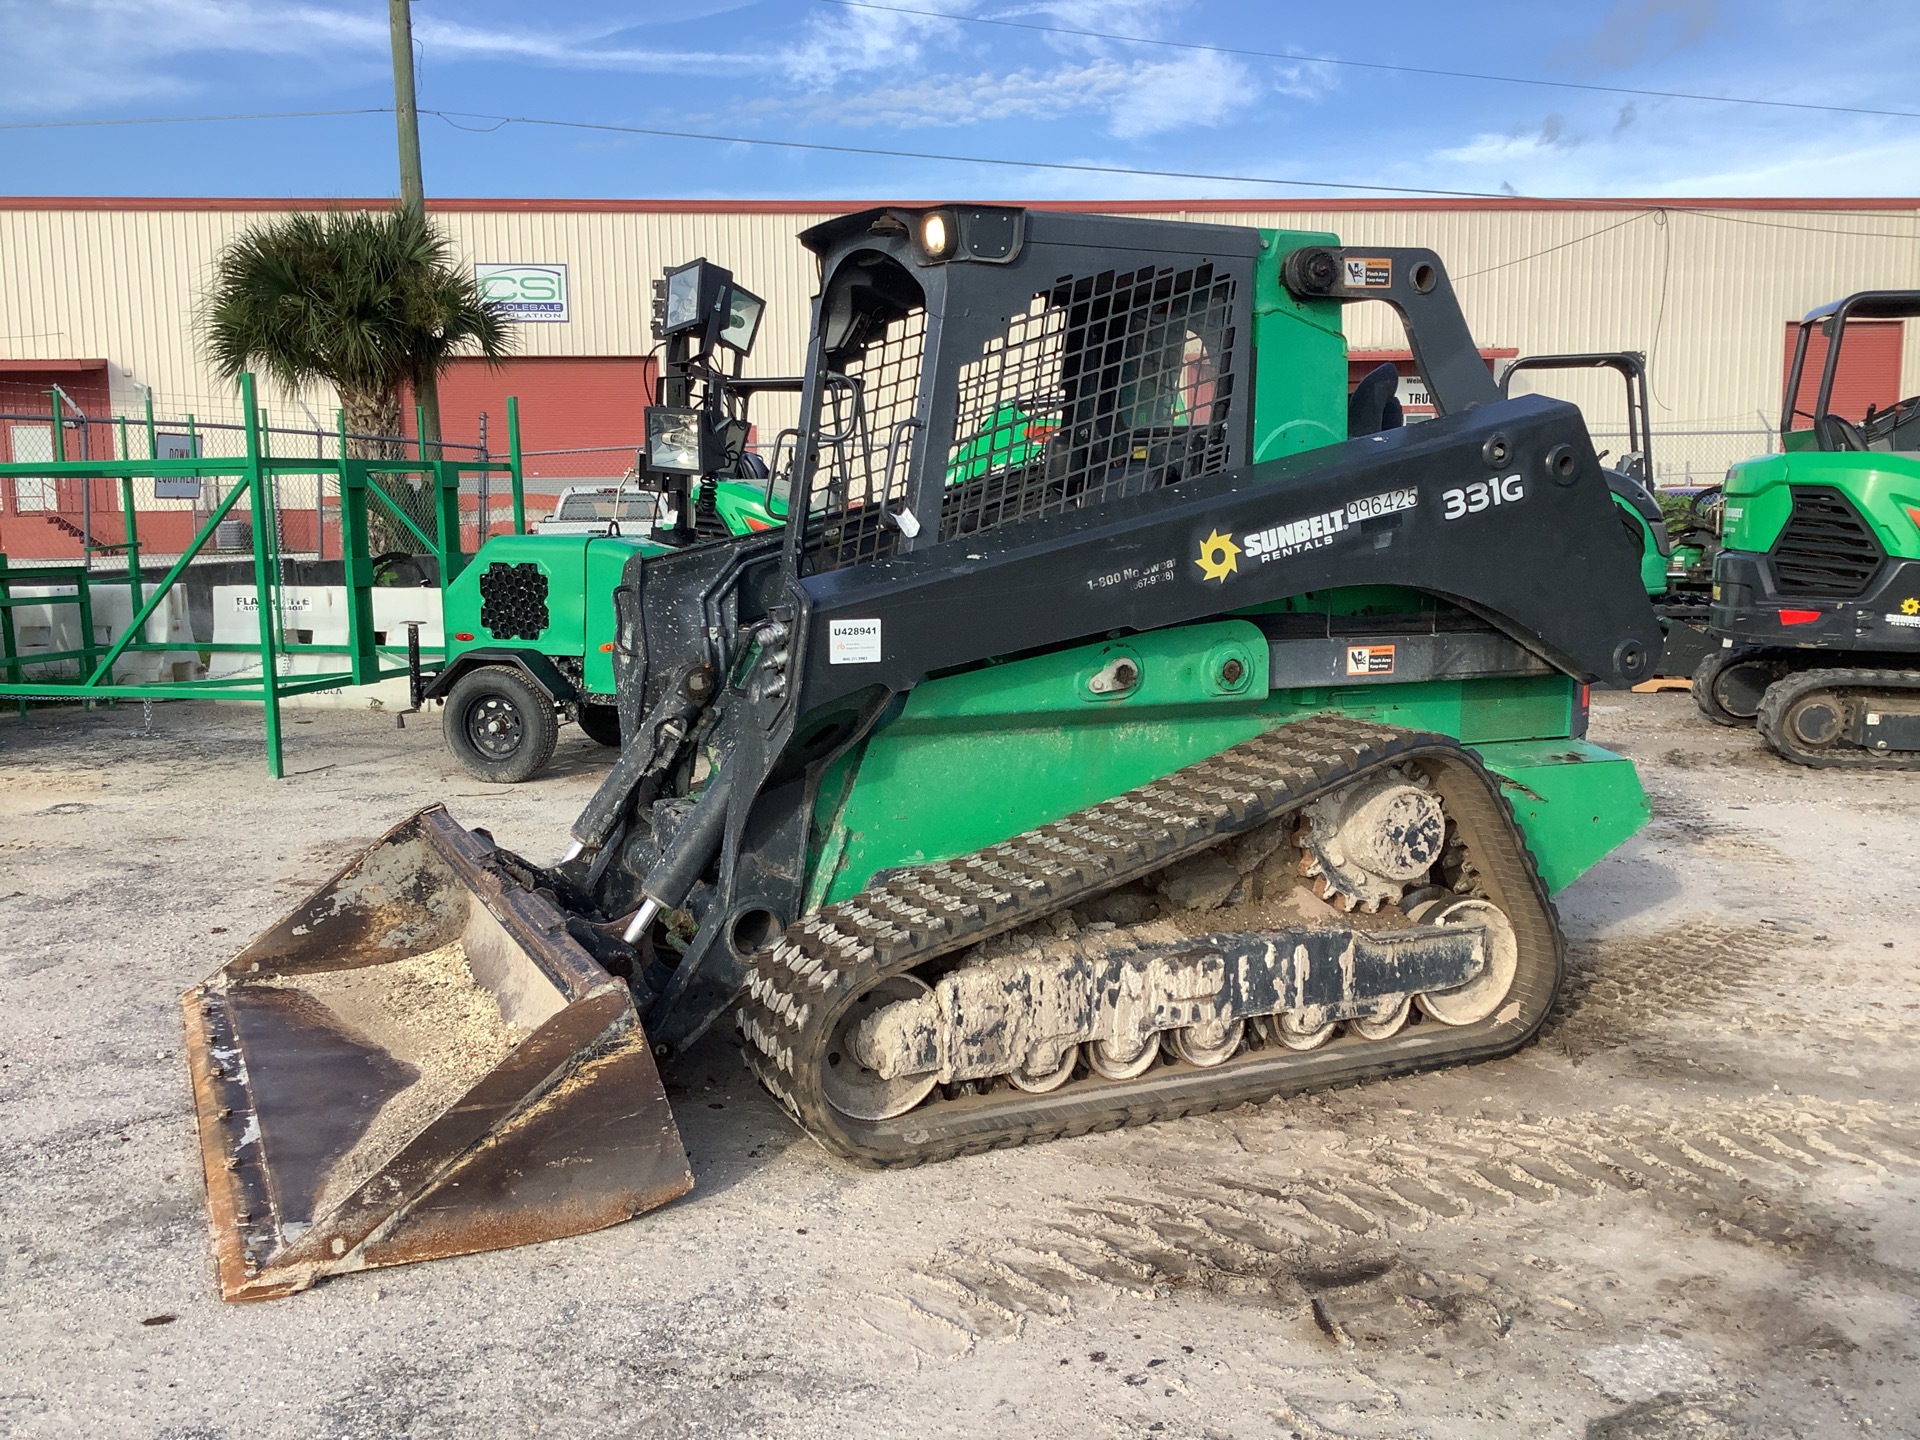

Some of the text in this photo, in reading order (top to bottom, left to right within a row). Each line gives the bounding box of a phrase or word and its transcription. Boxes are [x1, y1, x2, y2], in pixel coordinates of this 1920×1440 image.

[1347, 486, 1418, 519] 996425
[1442, 474, 1524, 520] 331G
[1243, 509, 1345, 557] SUNBELT
[1261, 535, 1334, 563] RENTALS
[1086, 572, 1121, 591] 1-800
[1123, 567, 1140, 580] No
[834, 626, 877, 637] U428941
